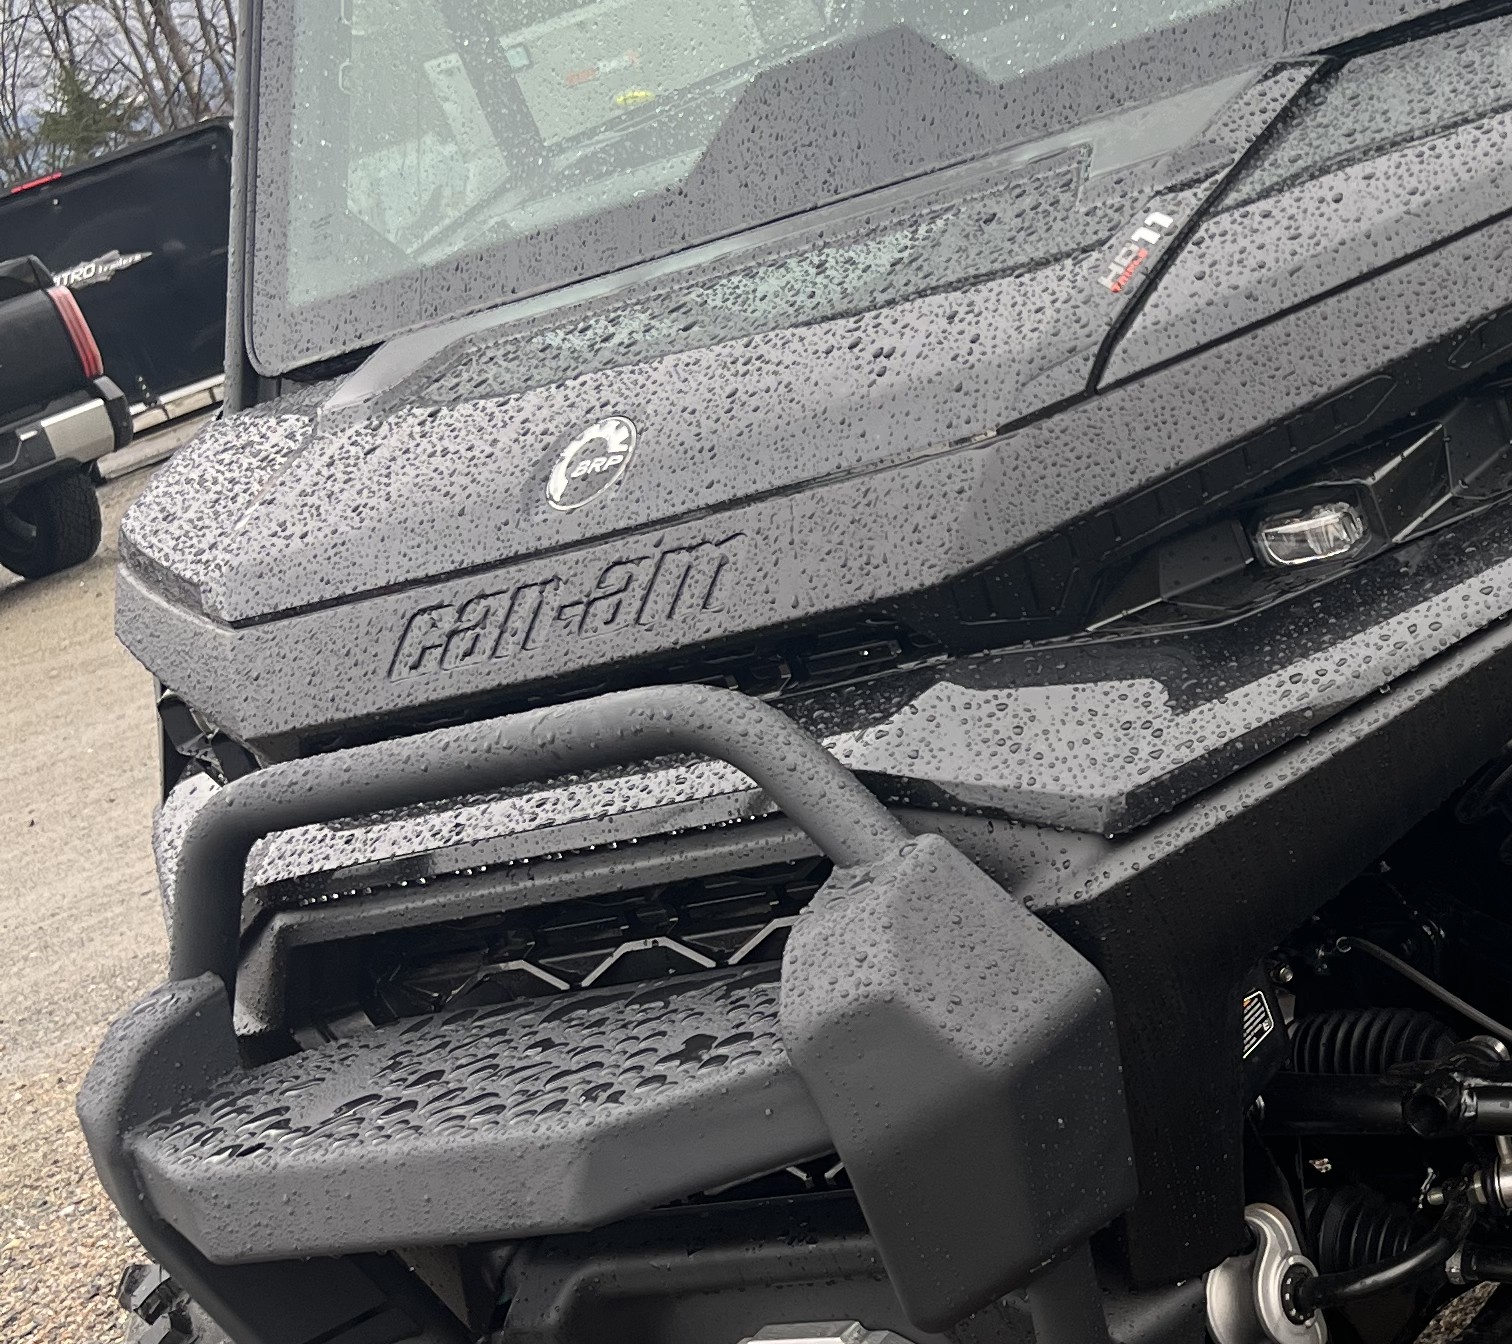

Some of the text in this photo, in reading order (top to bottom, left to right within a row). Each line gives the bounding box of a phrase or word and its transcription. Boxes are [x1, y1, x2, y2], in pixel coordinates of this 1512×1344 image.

[53, 262, 96, 287] ITRO
[570, 454, 624, 478] BRP
[386, 532, 748, 684] can-am
